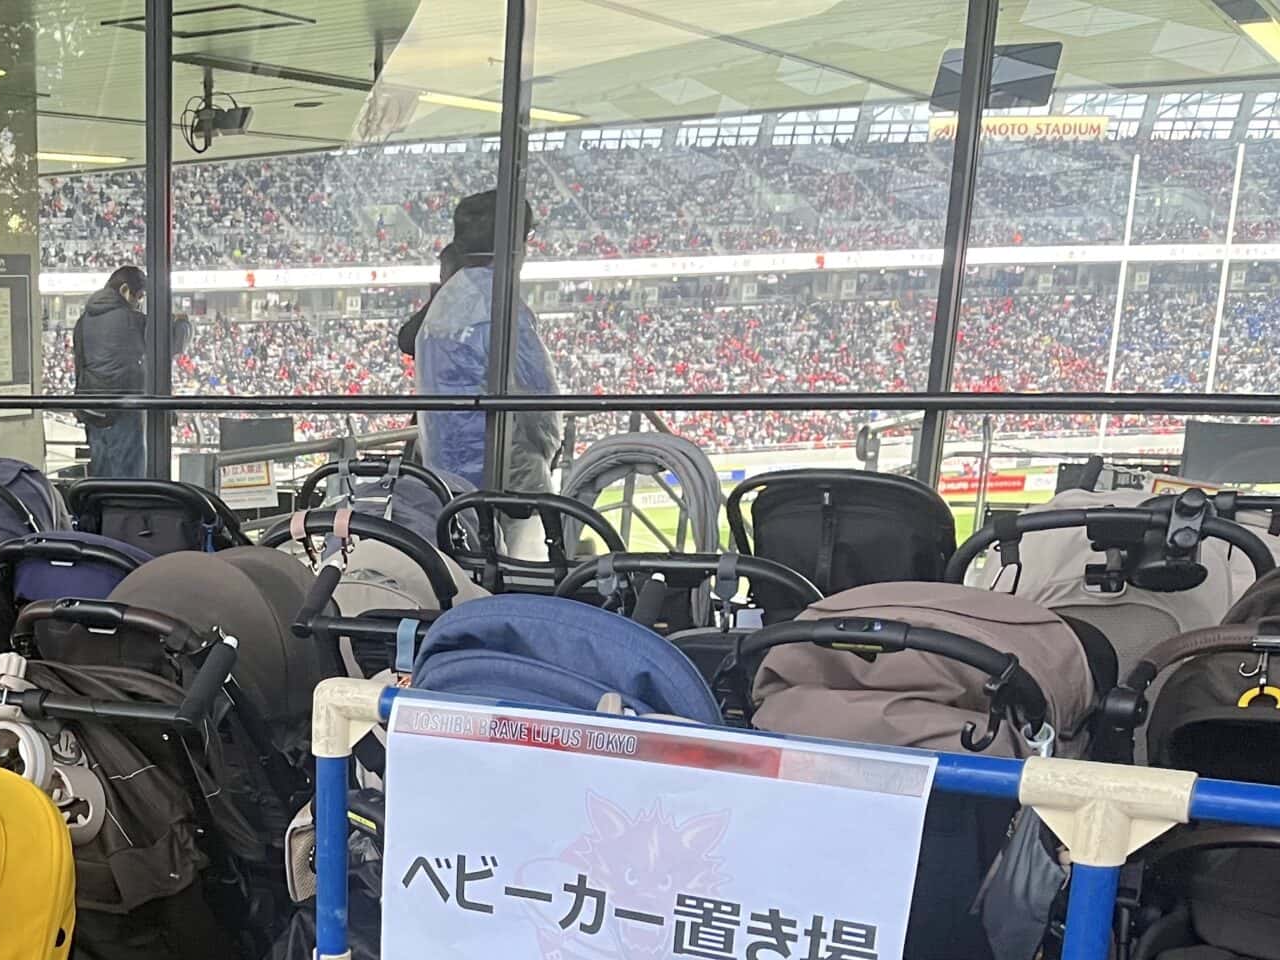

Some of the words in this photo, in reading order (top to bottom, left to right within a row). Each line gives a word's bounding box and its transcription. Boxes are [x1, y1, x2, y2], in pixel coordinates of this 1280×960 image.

[934, 122, 1028, 137] AJMOTO
[1035, 122, 1102, 136] STADIUM
[412, 711, 473, 735] TOSHIBA
[478, 718, 529, 740] BRAVE
[531, 724, 580, 748] LUPUS
[585, 730, 638, 754] TOKYO
